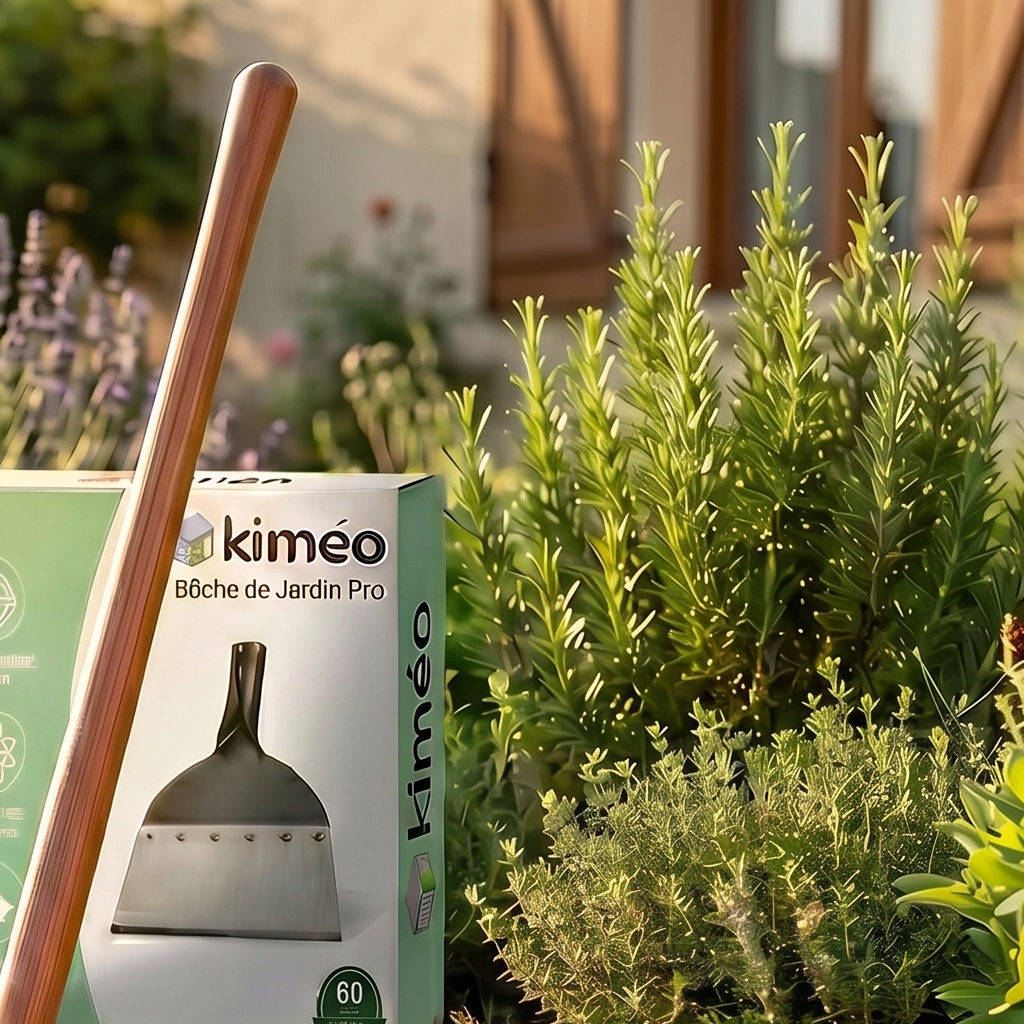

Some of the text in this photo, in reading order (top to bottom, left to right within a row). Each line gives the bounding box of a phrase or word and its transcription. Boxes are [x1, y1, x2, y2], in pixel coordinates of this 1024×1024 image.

[223, 514, 387, 565] kiméo
[244, 578, 271, 599] de
[276, 579, 341, 600] Jardin
[348, 579, 385, 600] Pro
[406, 600, 433, 842] kiméo
[336, 980, 363, 1005] 60
